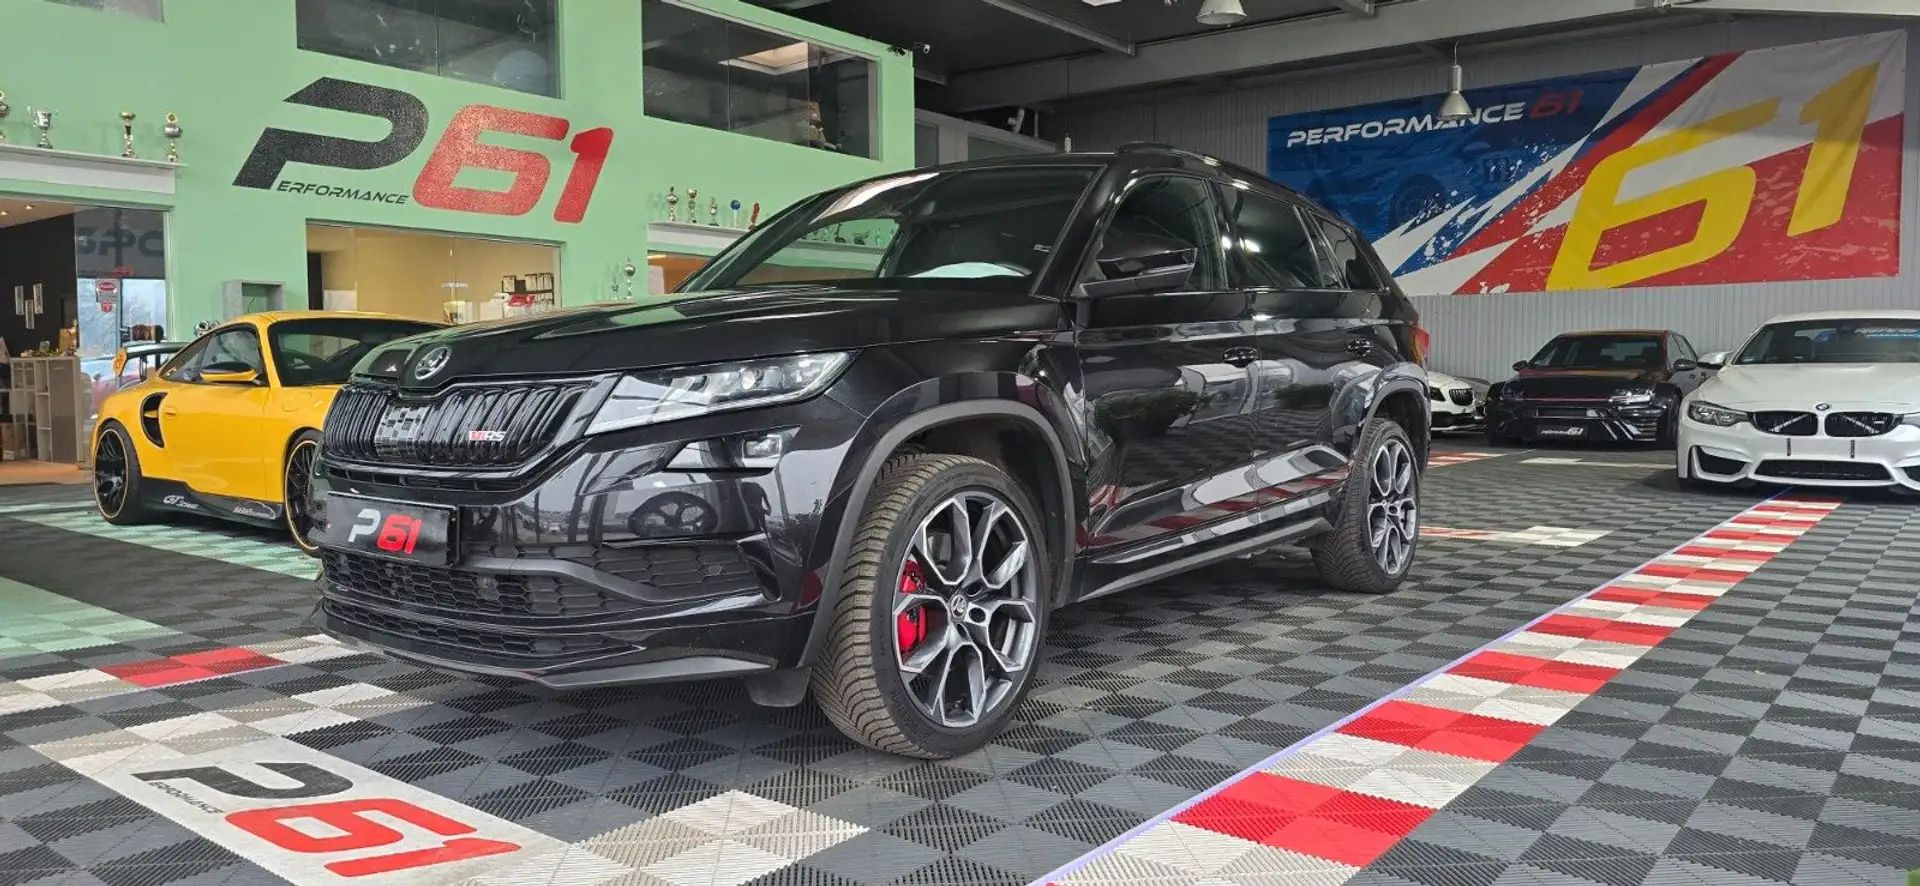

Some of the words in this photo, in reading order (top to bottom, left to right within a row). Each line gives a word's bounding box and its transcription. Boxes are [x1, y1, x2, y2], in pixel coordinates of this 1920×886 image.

[232, 76, 615, 224] P61
[1530, 91, 1585, 118] 61
[1545, 61, 1880, 292] 61
[347, 508, 423, 555] P61
[130, 762, 522, 877] P61
